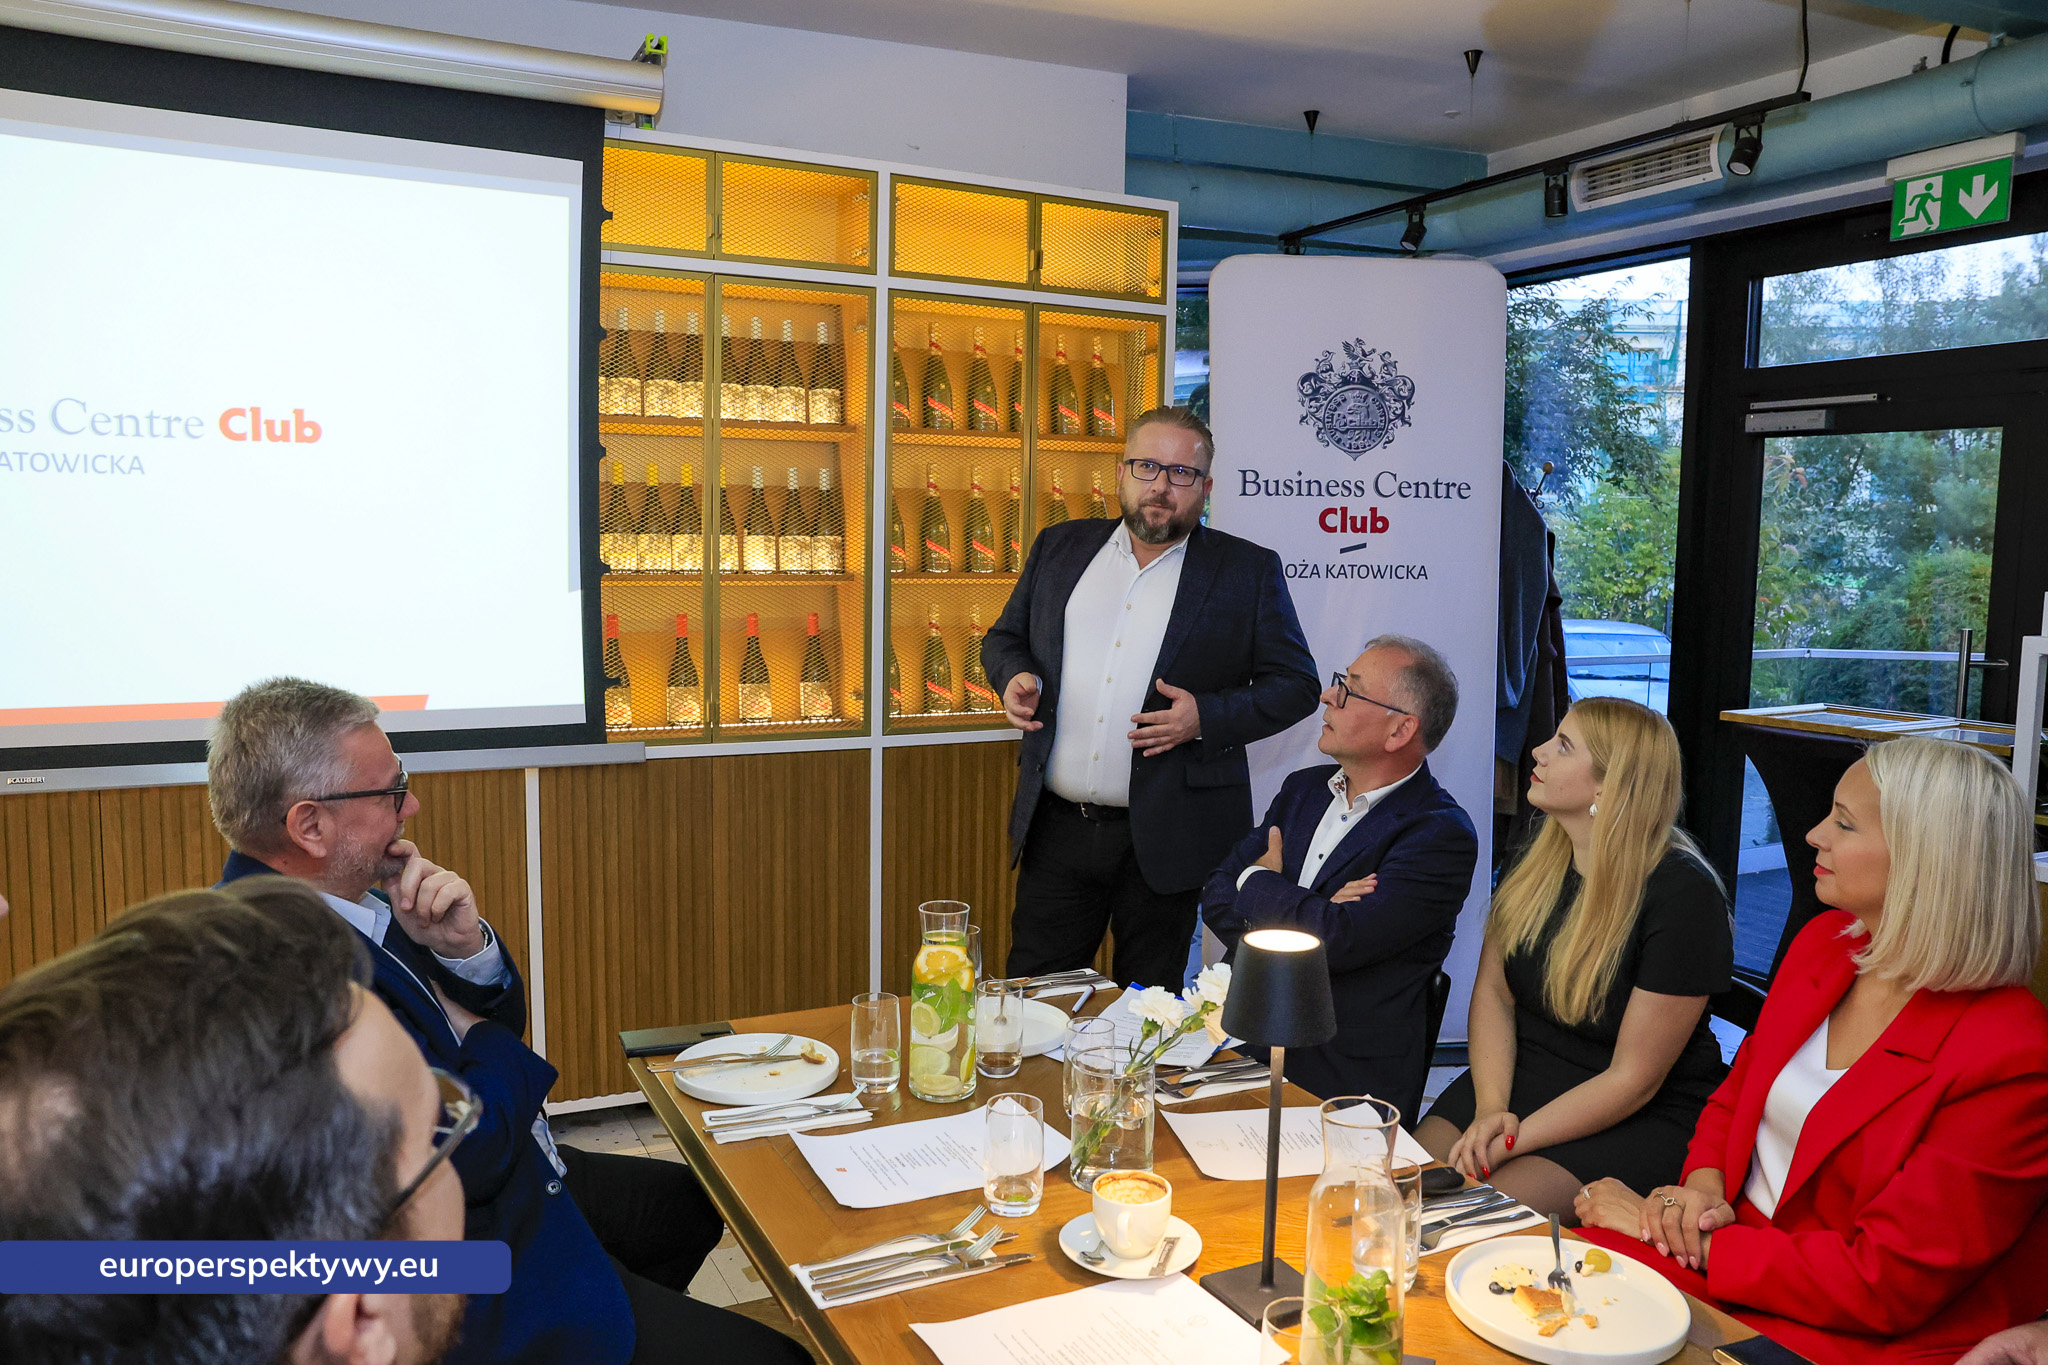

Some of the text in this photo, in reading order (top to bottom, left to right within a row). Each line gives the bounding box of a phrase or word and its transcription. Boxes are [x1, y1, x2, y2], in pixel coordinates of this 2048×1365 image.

[50, 398, 205, 439] Centre
[218, 406, 323, 444] Club
[0, 451, 146, 476] ATOWICKA
[1238, 469, 1472, 500] Business Centre
[1318, 506, 1390, 534] Club
[1283, 559, 1429, 580] OŻA KATOWICKA
